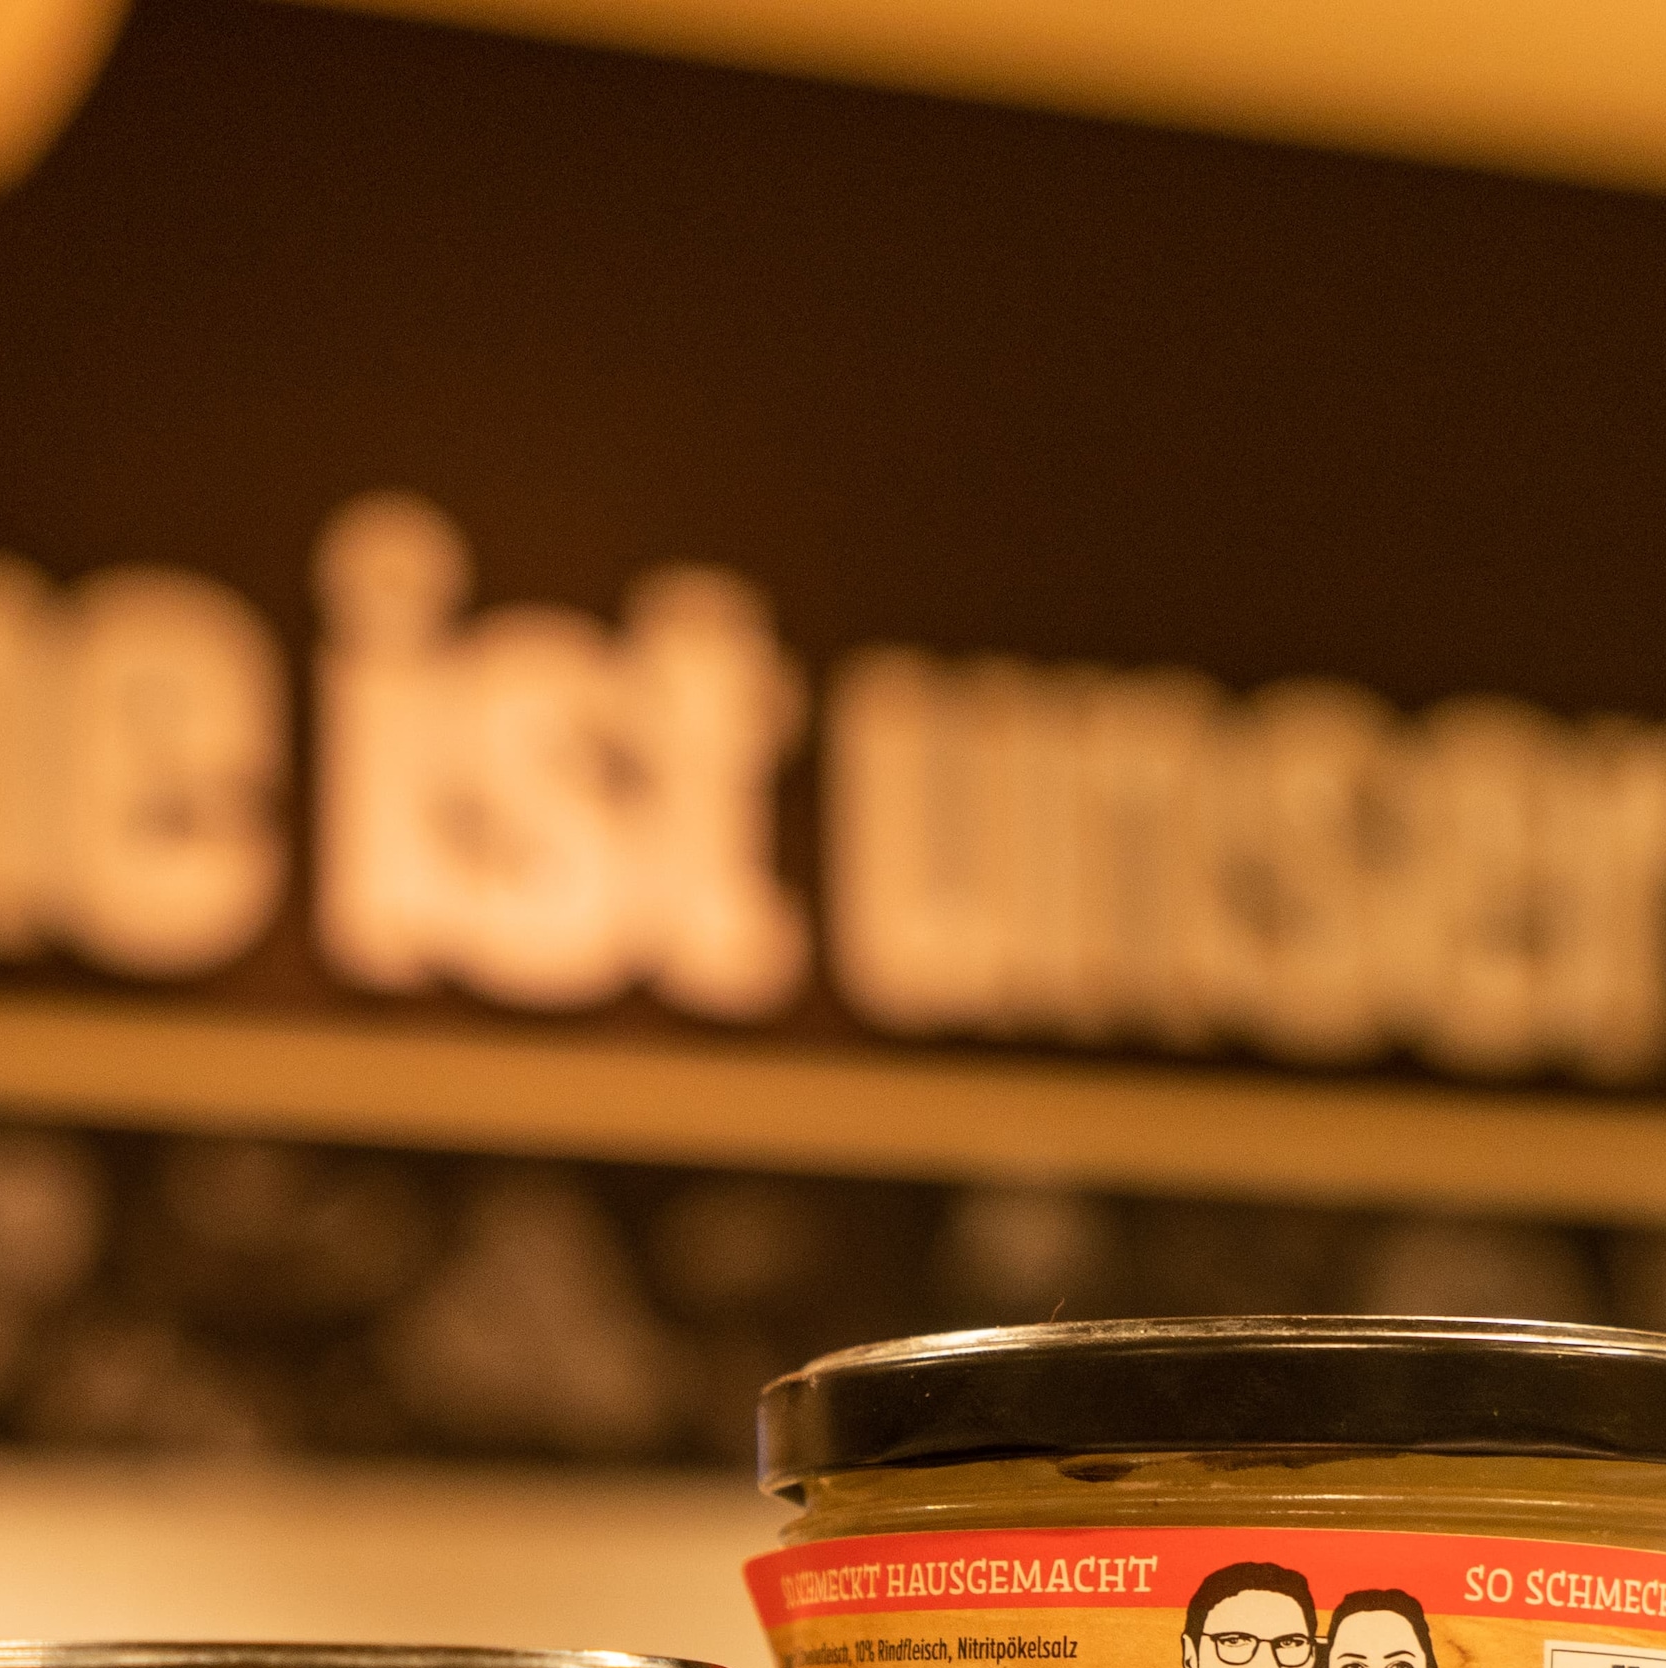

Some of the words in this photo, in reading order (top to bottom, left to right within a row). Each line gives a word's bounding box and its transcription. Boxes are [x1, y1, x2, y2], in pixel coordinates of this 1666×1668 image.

[318, 495, 810, 1014] ist
[886, 1554, 1159, 1599] HAUSGEMACHT
[1464, 1564, 1514, 1603] SO
[877, 1637, 952, 1664] Rindfleisch,
[957, 1635, 1078, 1665] Nitritpökelsalz
